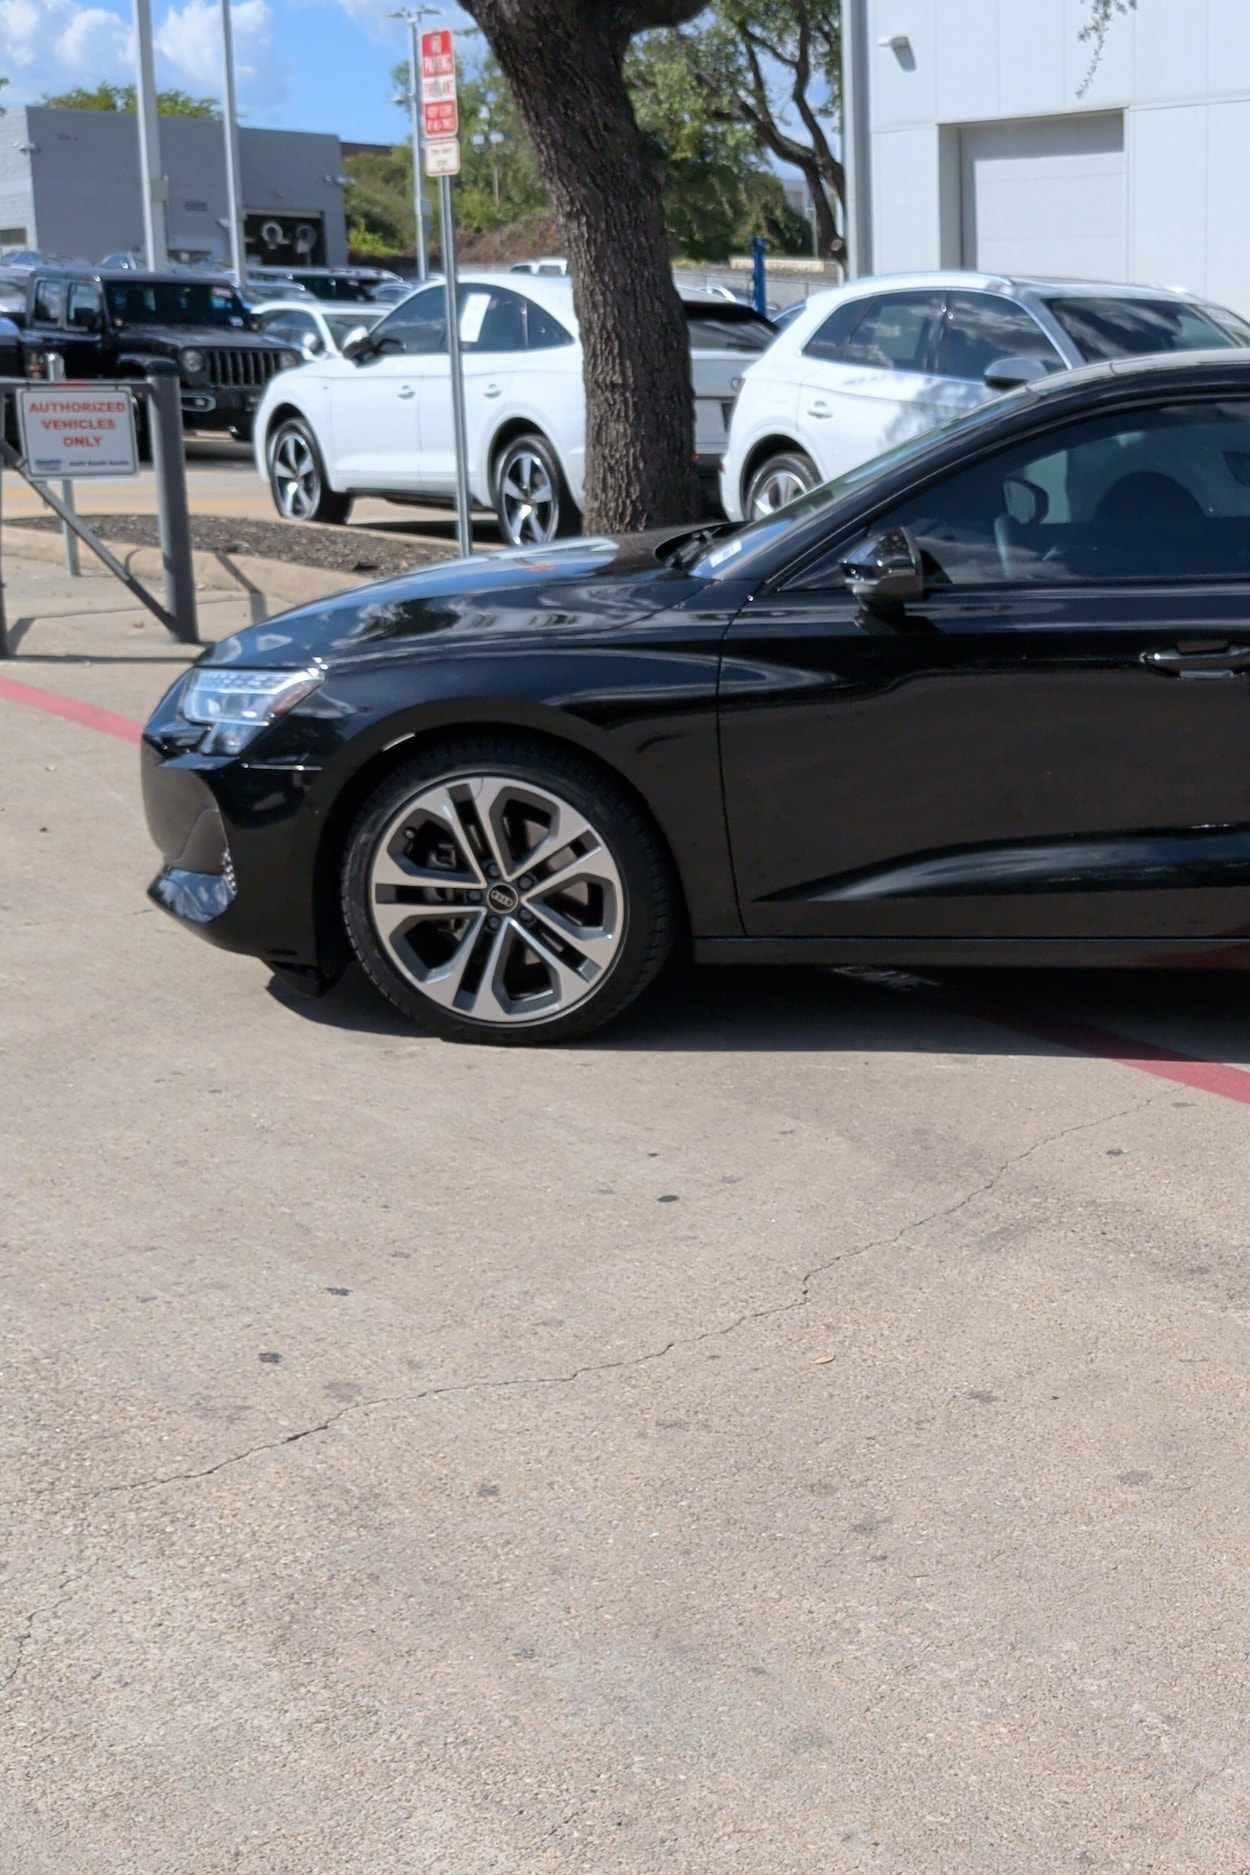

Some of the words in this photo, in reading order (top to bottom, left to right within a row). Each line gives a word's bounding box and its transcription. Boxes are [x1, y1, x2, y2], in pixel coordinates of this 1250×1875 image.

[29, 402, 126, 413] AUTHORIZED
[42, 418, 116, 430] VEHICLES
[62, 436, 102, 447] ONLY
